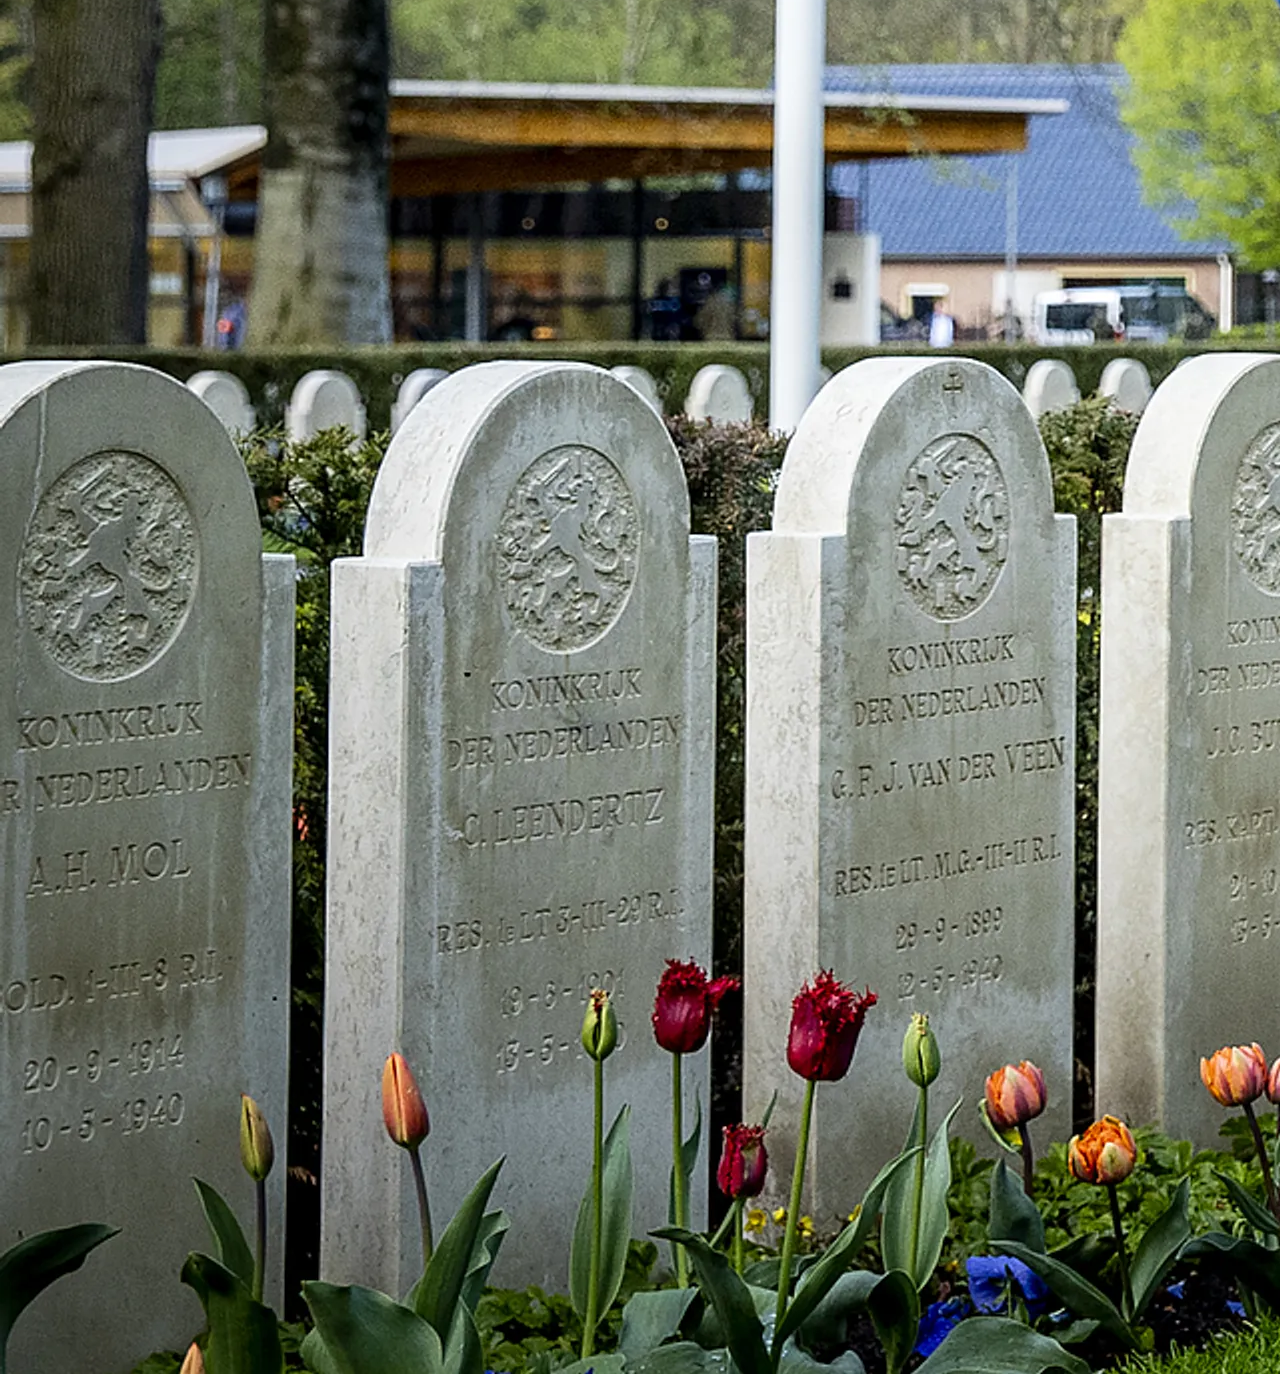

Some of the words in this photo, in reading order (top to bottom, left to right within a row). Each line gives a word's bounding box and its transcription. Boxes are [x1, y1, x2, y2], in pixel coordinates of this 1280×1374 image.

[887, 633, 1016, 675] KONINKRIJK
[490, 667, 642, 714] KONINKRIJK
[851, 696, 895, 729] DER
[901, 676, 1048, 722] NEDERLANDEN
[16, 701, 203, 753] KONINKRIJK
[447, 734, 495, 771] DER
[503, 713, 684, 766] NEDERLANDEN
[35, 752, 252, 812] NEDERLANDEN
[907, 758, 953, 789] VAN
[958, 752, 998, 784] DER
[1003, 735, 1067, 774] VEEN
[493, 787, 666, 846] LEENDERTZ
[106, 837, 192, 888] MOL
